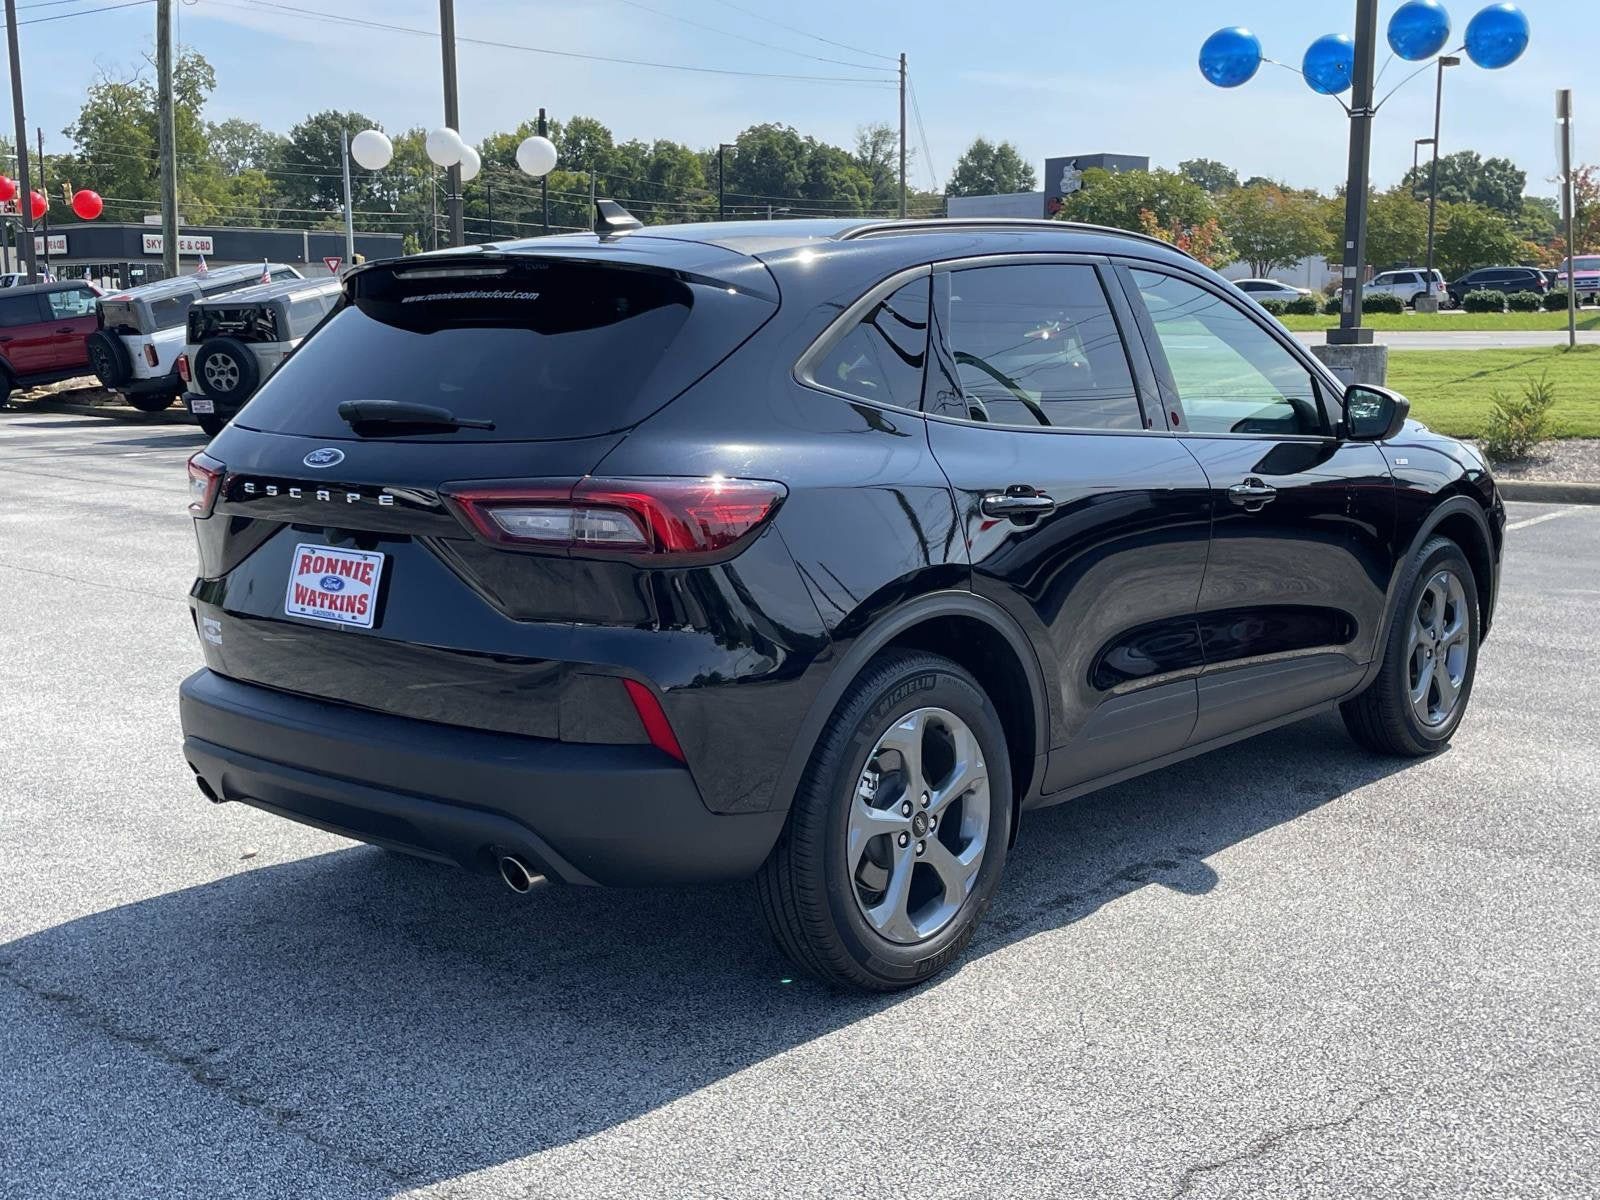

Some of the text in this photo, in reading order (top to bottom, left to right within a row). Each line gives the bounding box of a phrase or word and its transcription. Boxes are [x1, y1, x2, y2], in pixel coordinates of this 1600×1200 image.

[146, 239, 162, 249] SKY
[187, 241, 193, 250] &
[195, 241, 211, 250] CBD
[401, 289, 540, 303] www.ronniewatkinsford.com
[244, 482, 394, 506] ESCAPE
[298, 554, 375, 587] RONNIE
[322, 577, 342, 590] Ford
[295, 582, 369, 615] WATKINS
[879, 676, 936, 715] MICHELIN
